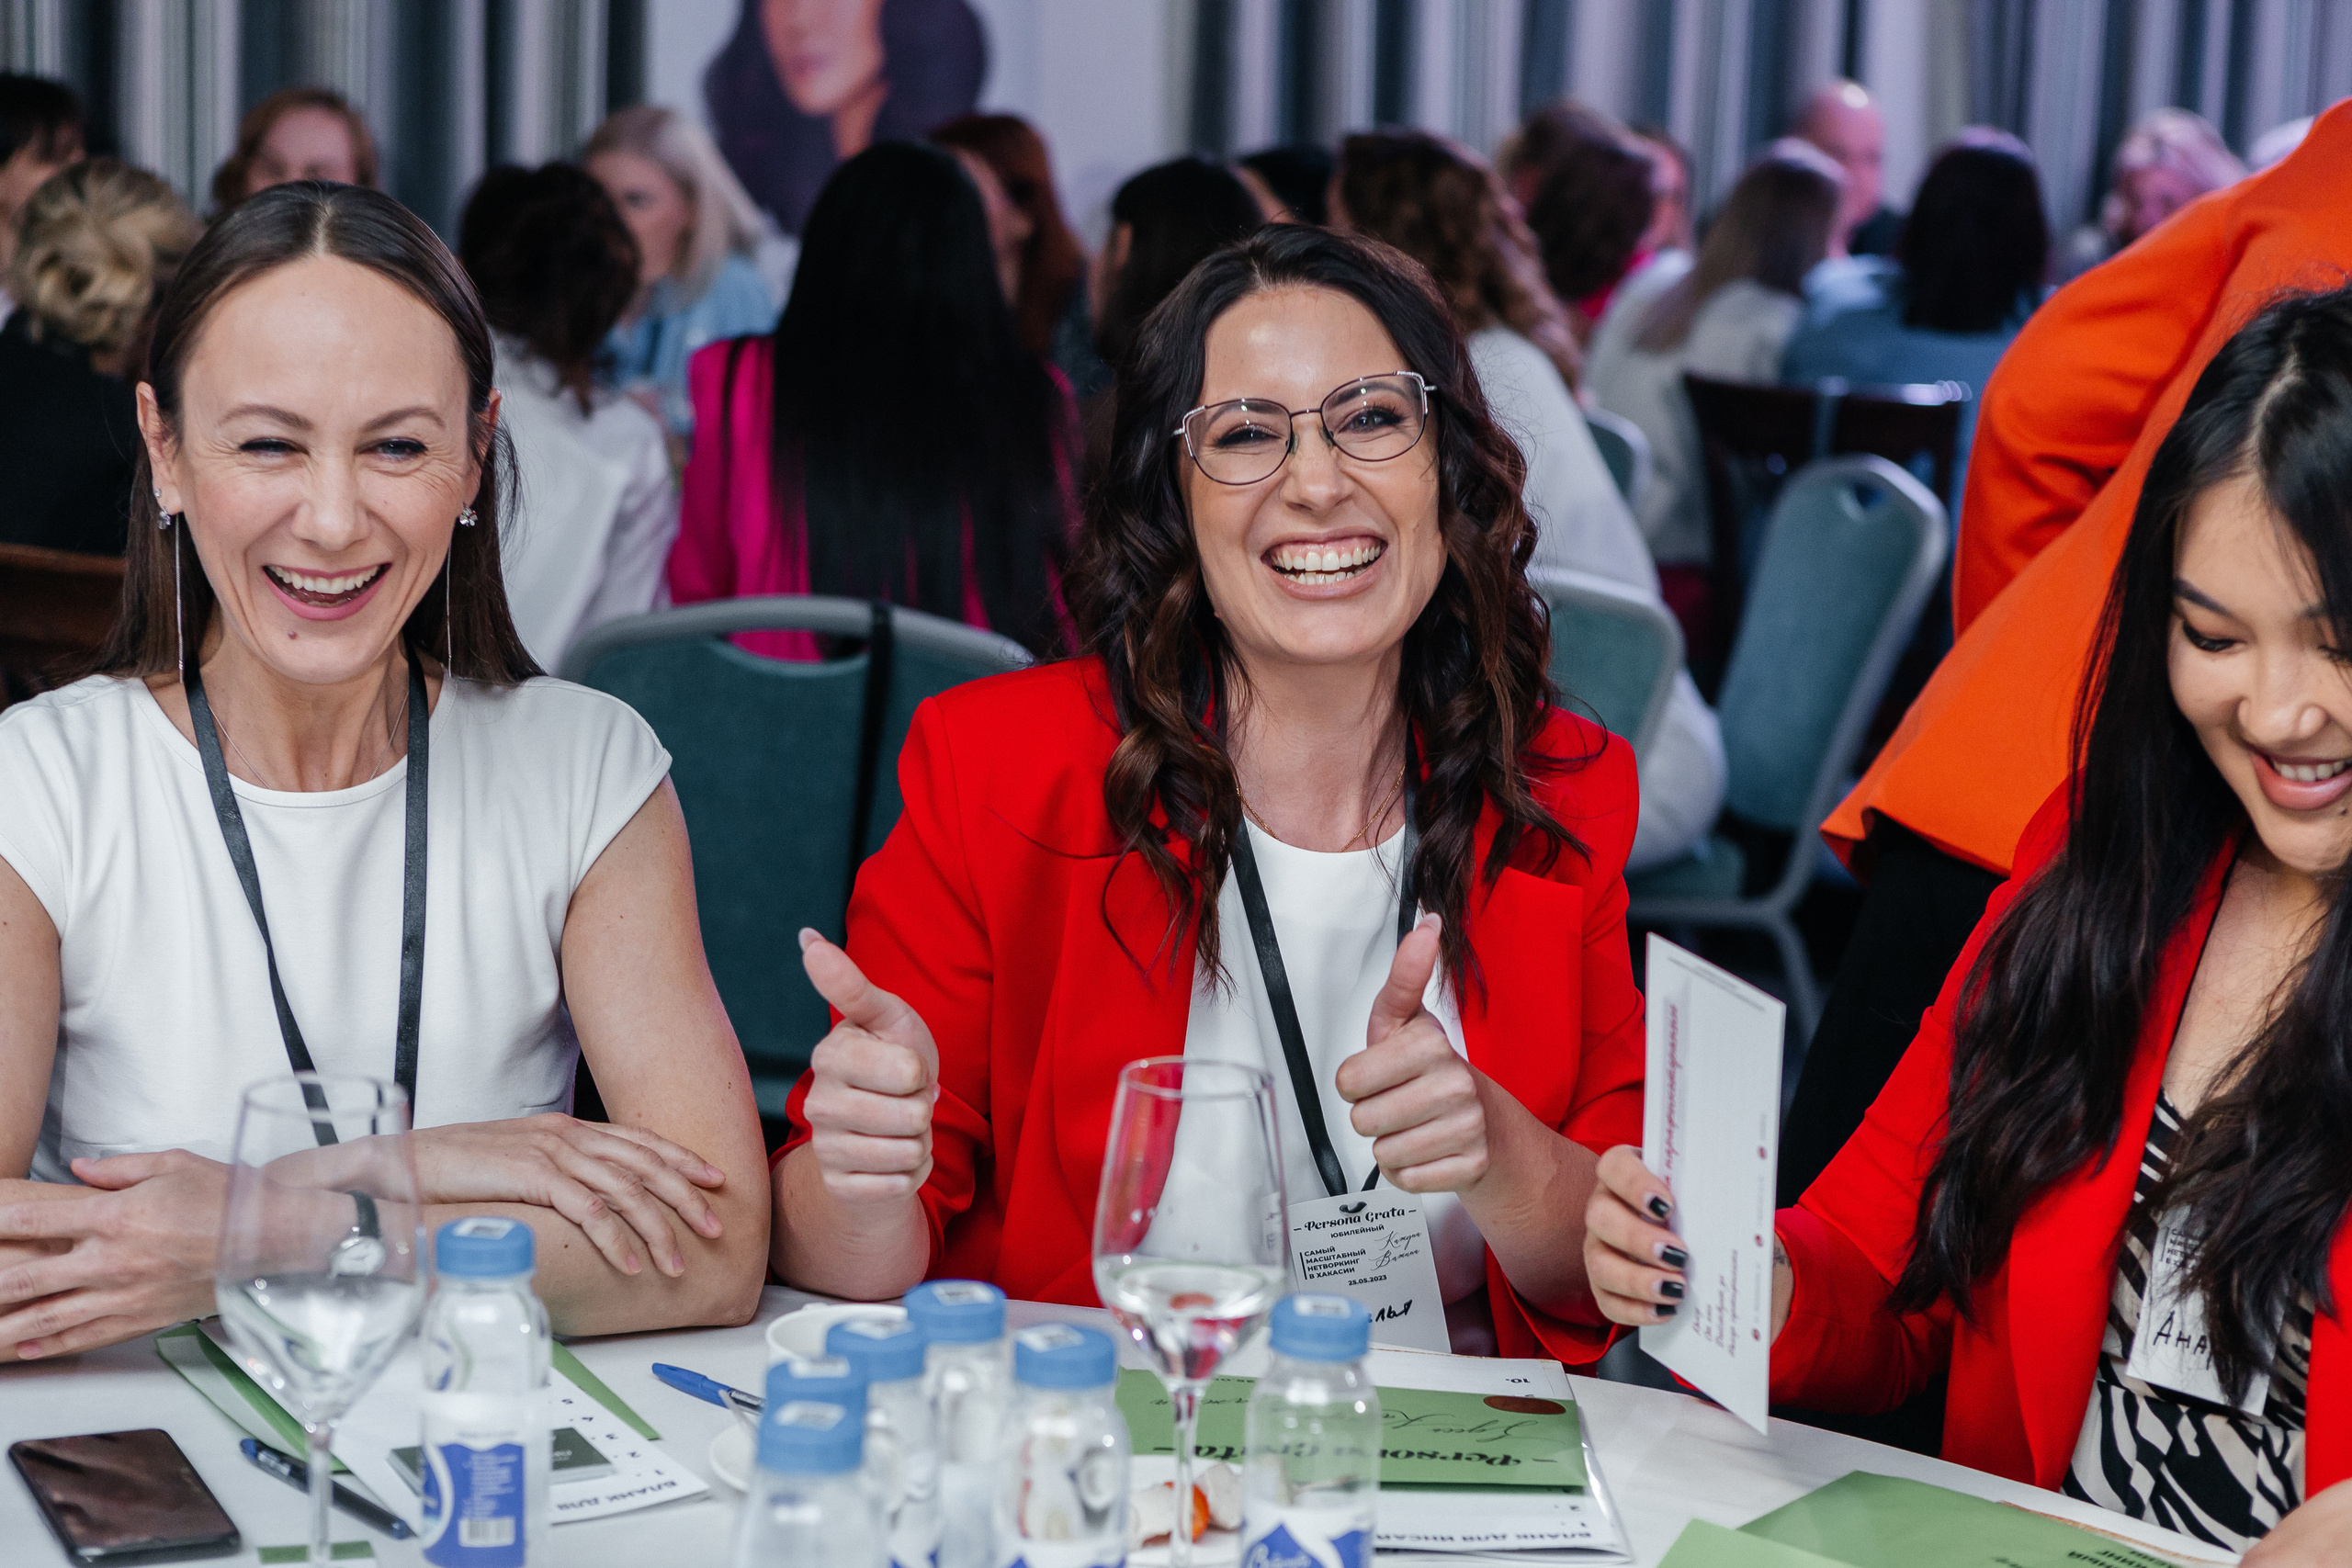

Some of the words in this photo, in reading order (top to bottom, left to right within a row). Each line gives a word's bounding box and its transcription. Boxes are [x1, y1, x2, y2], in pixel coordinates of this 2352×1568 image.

[1305, 1214, 1361, 1232] Persona
[1365, 1207, 1406, 1224] Grata
[1330, 1224, 1385, 1239] ЮБИЛЕЙНЫЙ
[1304, 1246, 1336, 1257] САМЫЙ
[1306, 1248, 1366, 1264] МАСШТАБНЫЙ
[1307, 1258, 1360, 1272] НЕТВОРКИНГ
[1317, 1267, 1355, 1279] ХАКАСИИ
[1348, 1274, 1388, 1286] 25.05.2023
